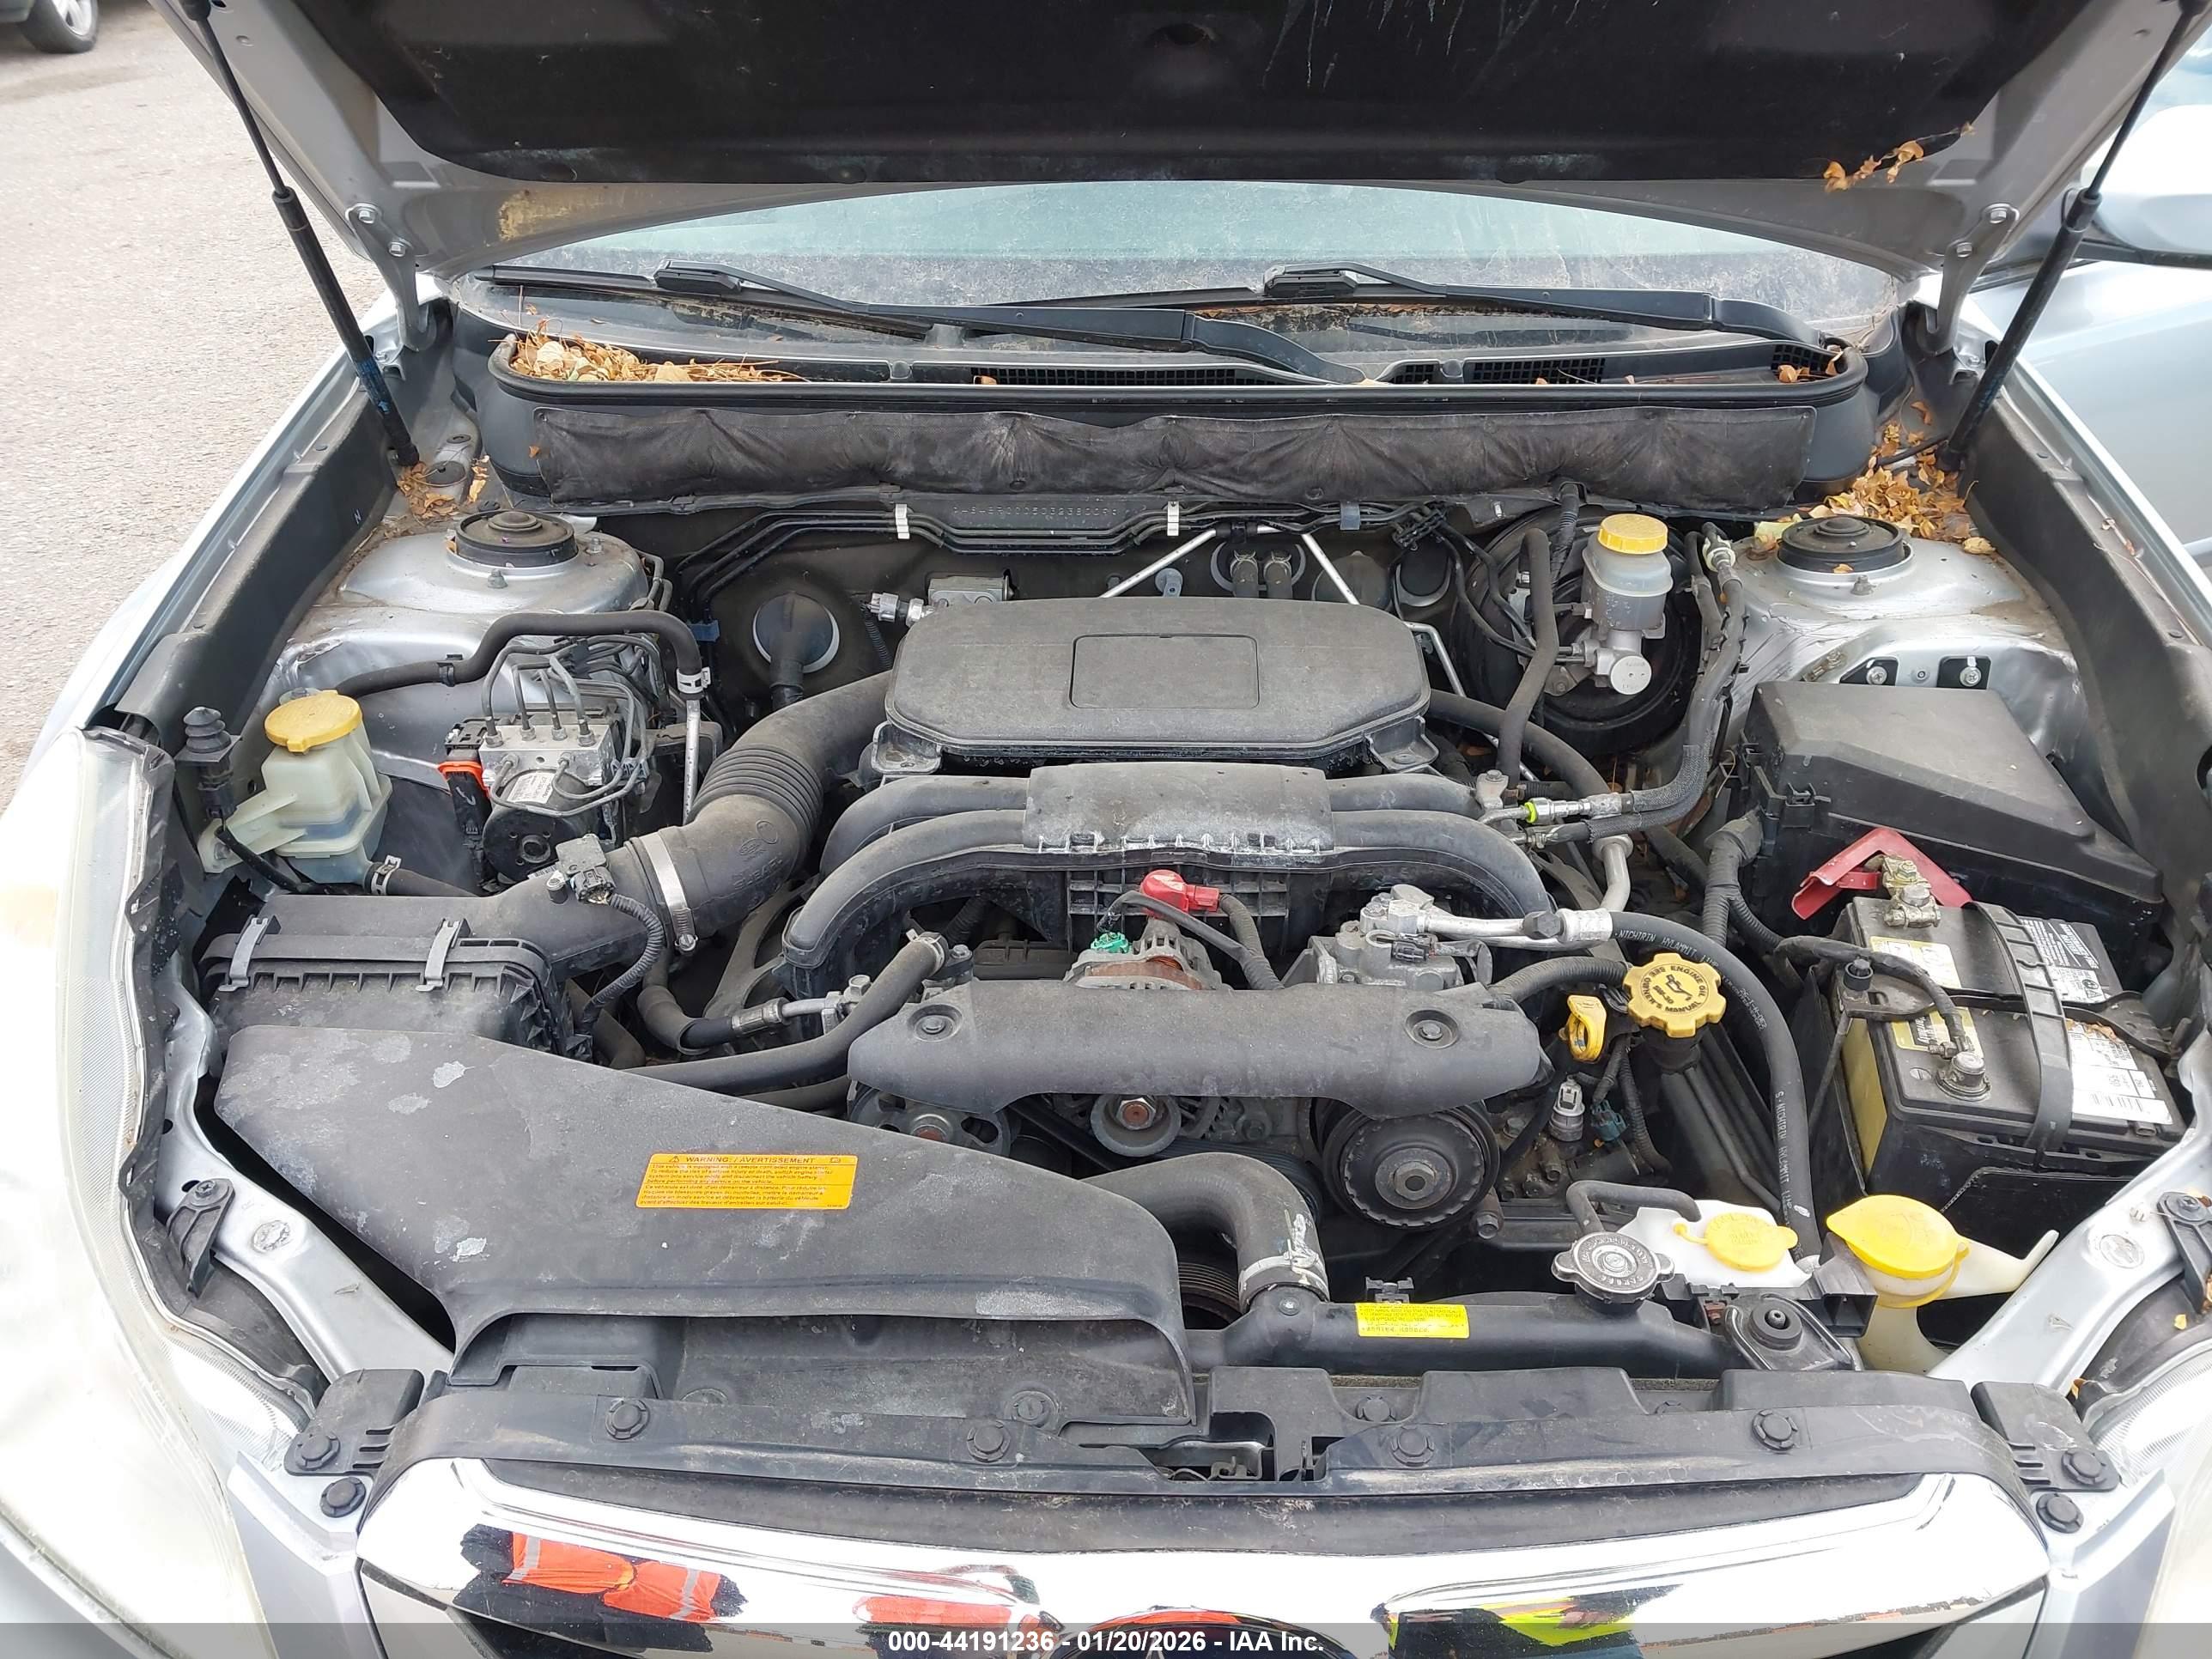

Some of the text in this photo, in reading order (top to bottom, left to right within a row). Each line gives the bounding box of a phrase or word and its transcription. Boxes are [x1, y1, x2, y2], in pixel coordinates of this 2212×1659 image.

[1641, 966, 1702, 1013] SEE OWNER'S MANUAL
[1653, 985, 1674, 1004] 5W-30
[1671, 966, 1707, 997] ENGINE OIL
